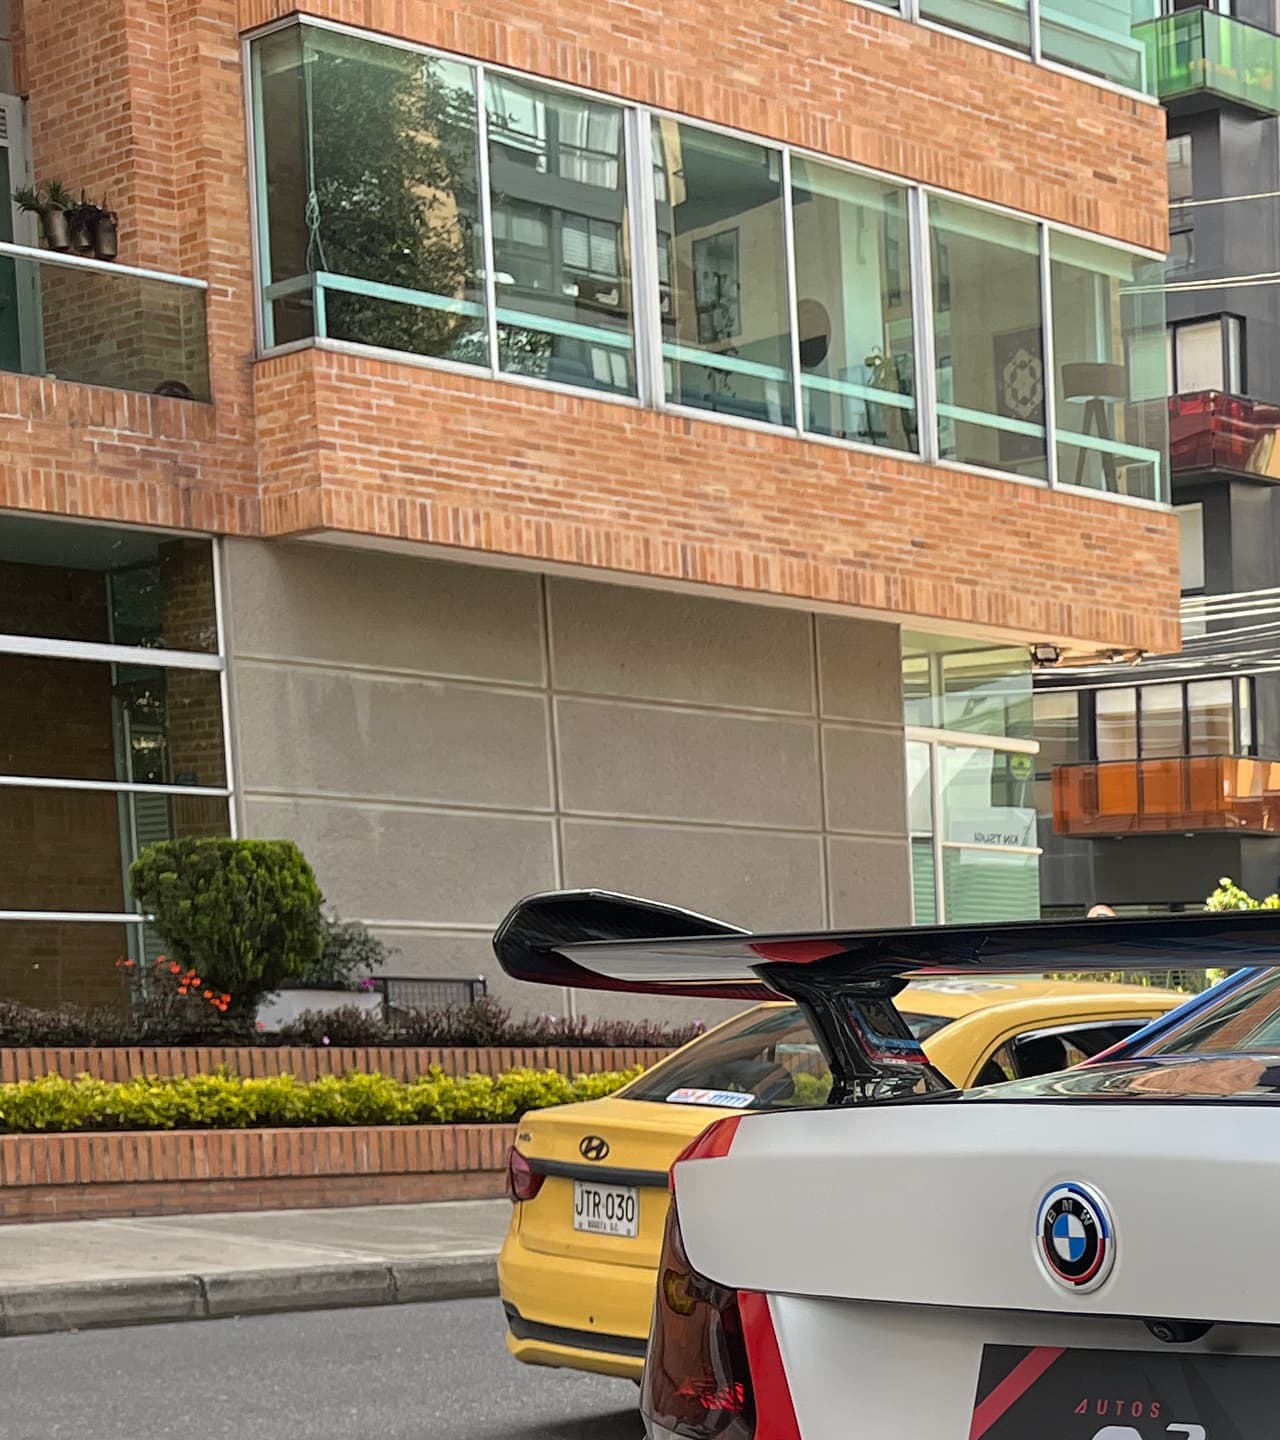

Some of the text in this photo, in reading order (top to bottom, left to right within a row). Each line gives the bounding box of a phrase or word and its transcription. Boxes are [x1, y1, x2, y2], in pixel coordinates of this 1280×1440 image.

[575, 1189, 635, 1222] JTR 030
[1046, 1199, 1094, 1226] BMW
[1074, 1398, 1162, 1419] AUTOS
